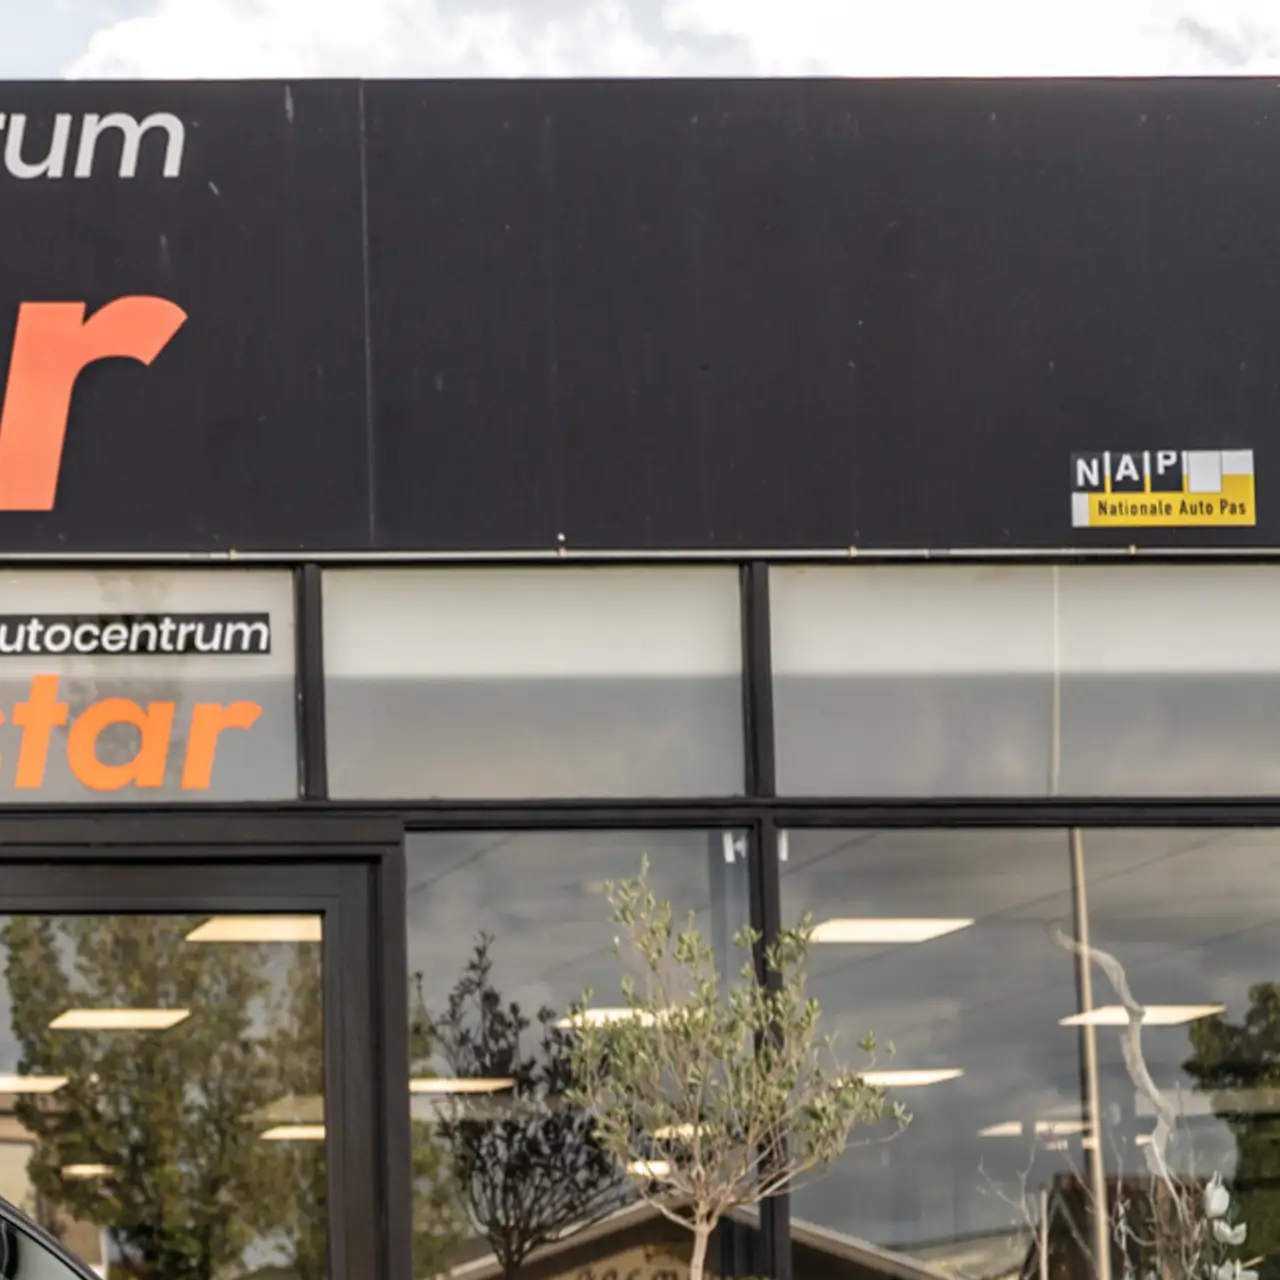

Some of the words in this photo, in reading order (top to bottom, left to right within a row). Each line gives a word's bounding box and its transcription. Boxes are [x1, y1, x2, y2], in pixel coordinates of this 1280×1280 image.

[1097, 499, 1173, 517] Nationale
[1178, 498, 1215, 516] Auto
[1219, 497, 1247, 516] Pas
